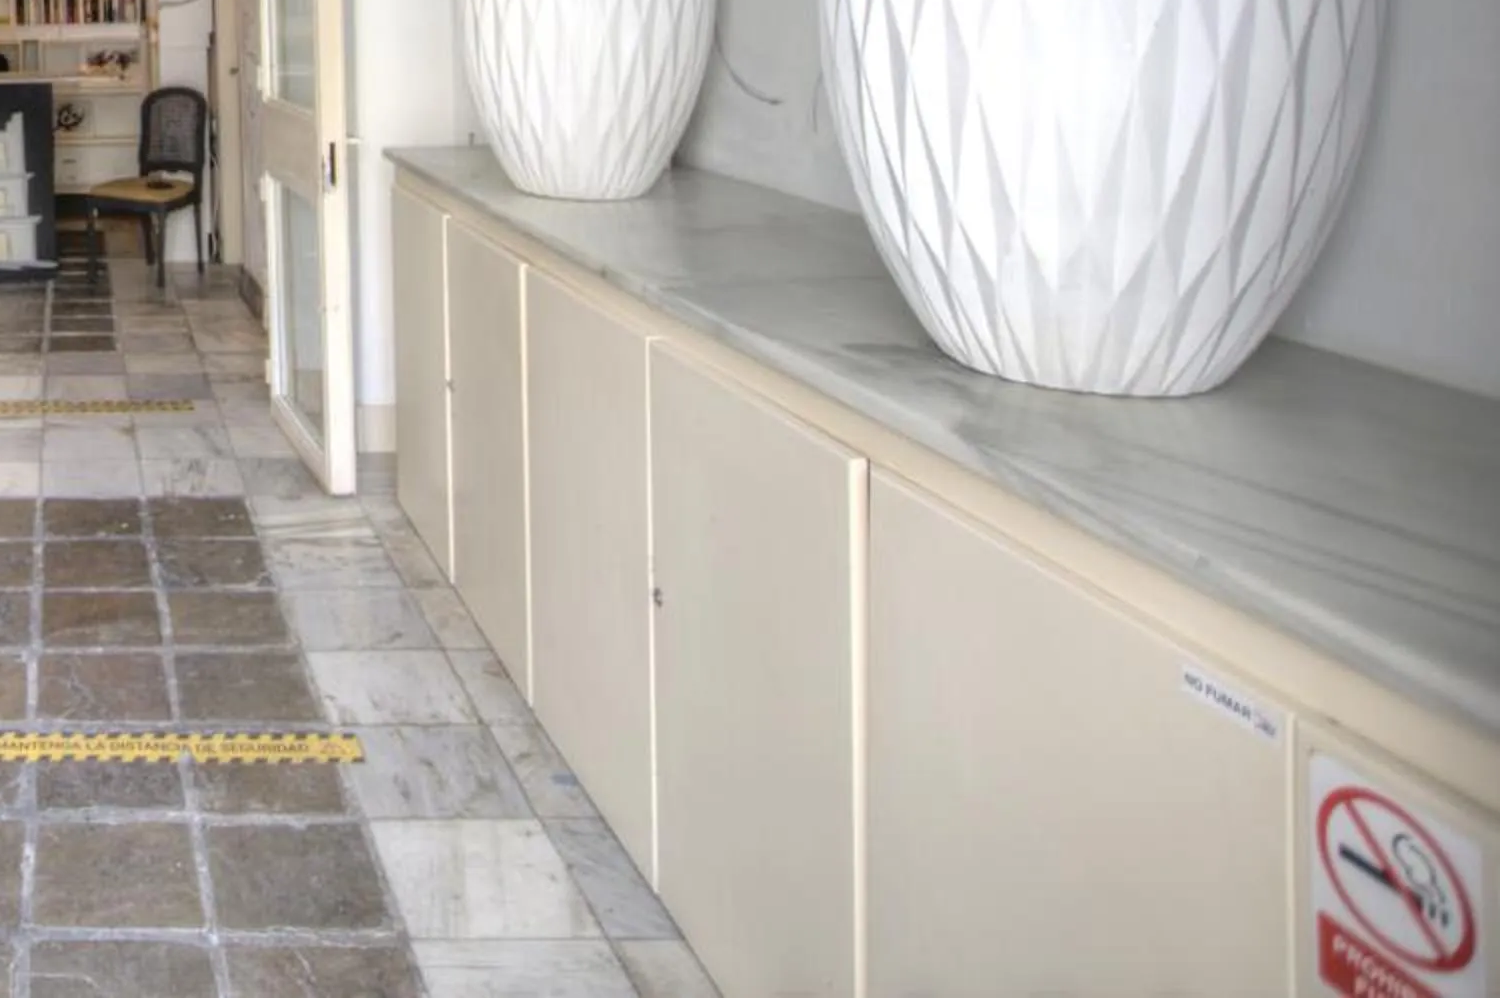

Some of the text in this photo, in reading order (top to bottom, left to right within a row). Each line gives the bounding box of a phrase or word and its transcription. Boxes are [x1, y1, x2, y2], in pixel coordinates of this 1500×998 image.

[1184, 671, 1250, 721] NO FUMAR
[86, 740, 105, 752] LA
[109, 740, 191, 753] DISTANCIA
[195, 742, 217, 754] DE
[219, 741, 310, 754] SEGURIDAD
